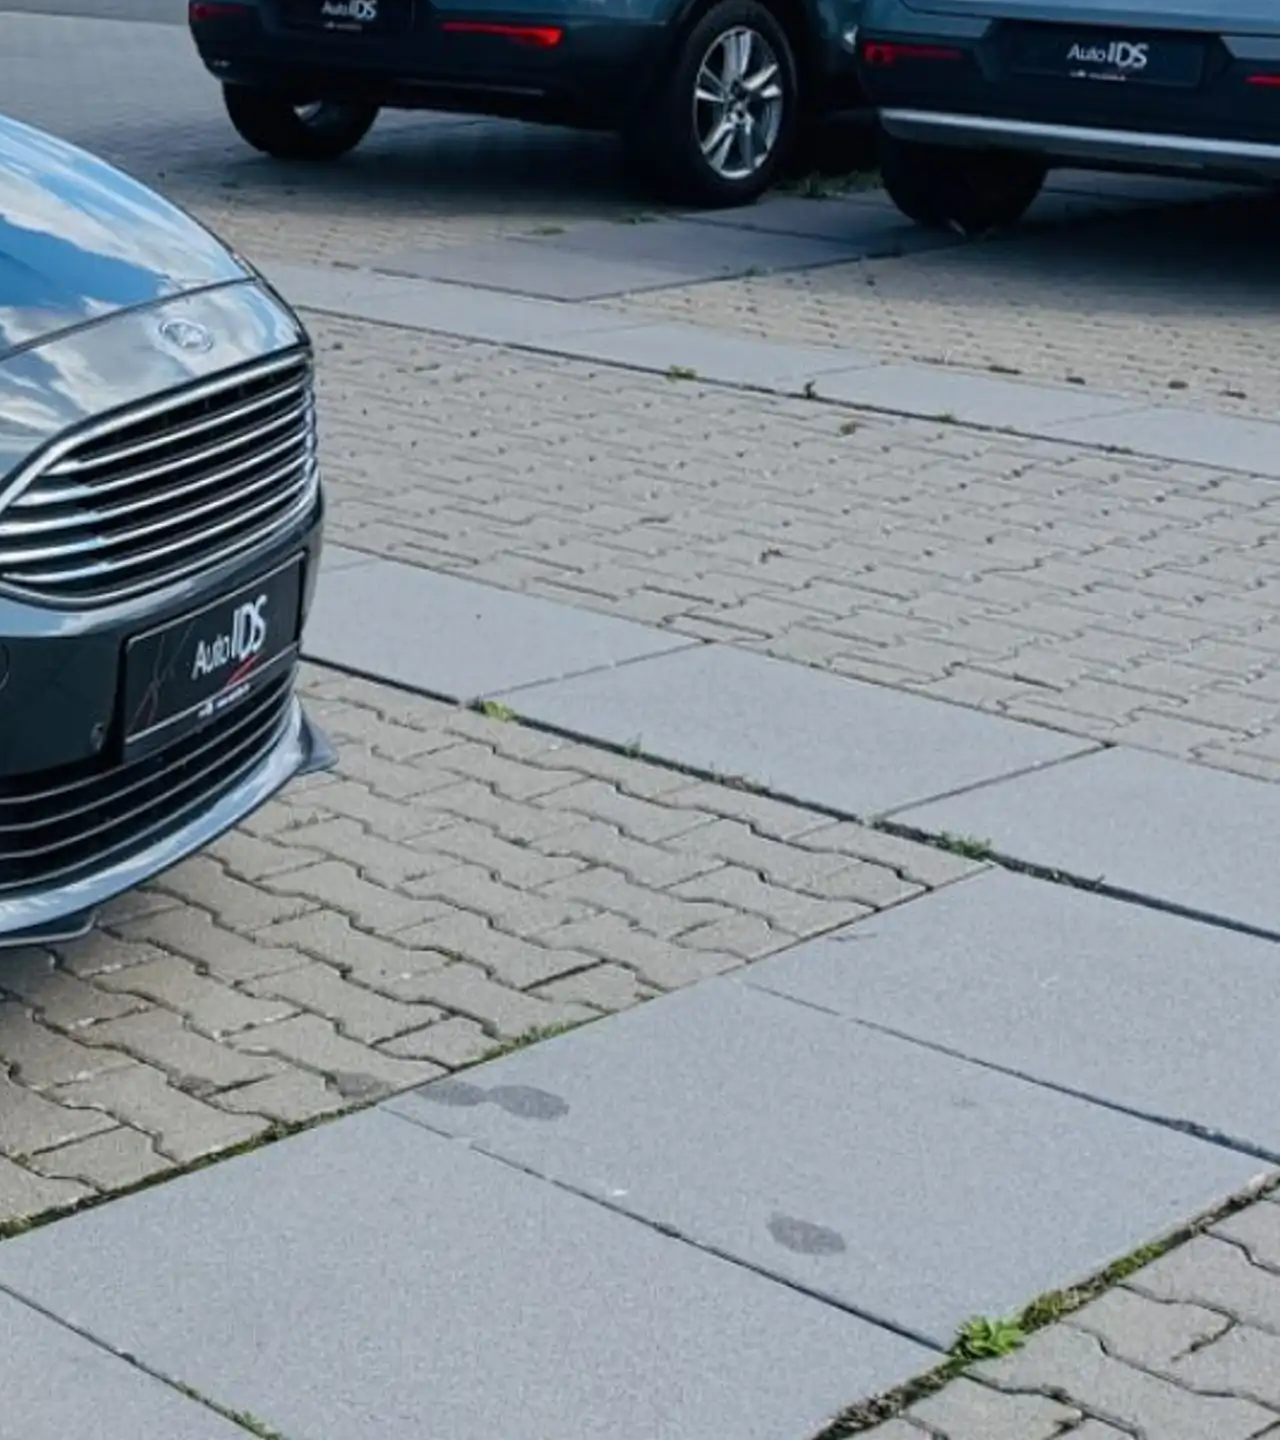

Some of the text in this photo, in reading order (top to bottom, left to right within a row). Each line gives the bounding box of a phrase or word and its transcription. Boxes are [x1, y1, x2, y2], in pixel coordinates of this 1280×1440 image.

[1067, 41, 1149, 69] Auto IDS
[191, 594, 268, 680] Auto IDS
